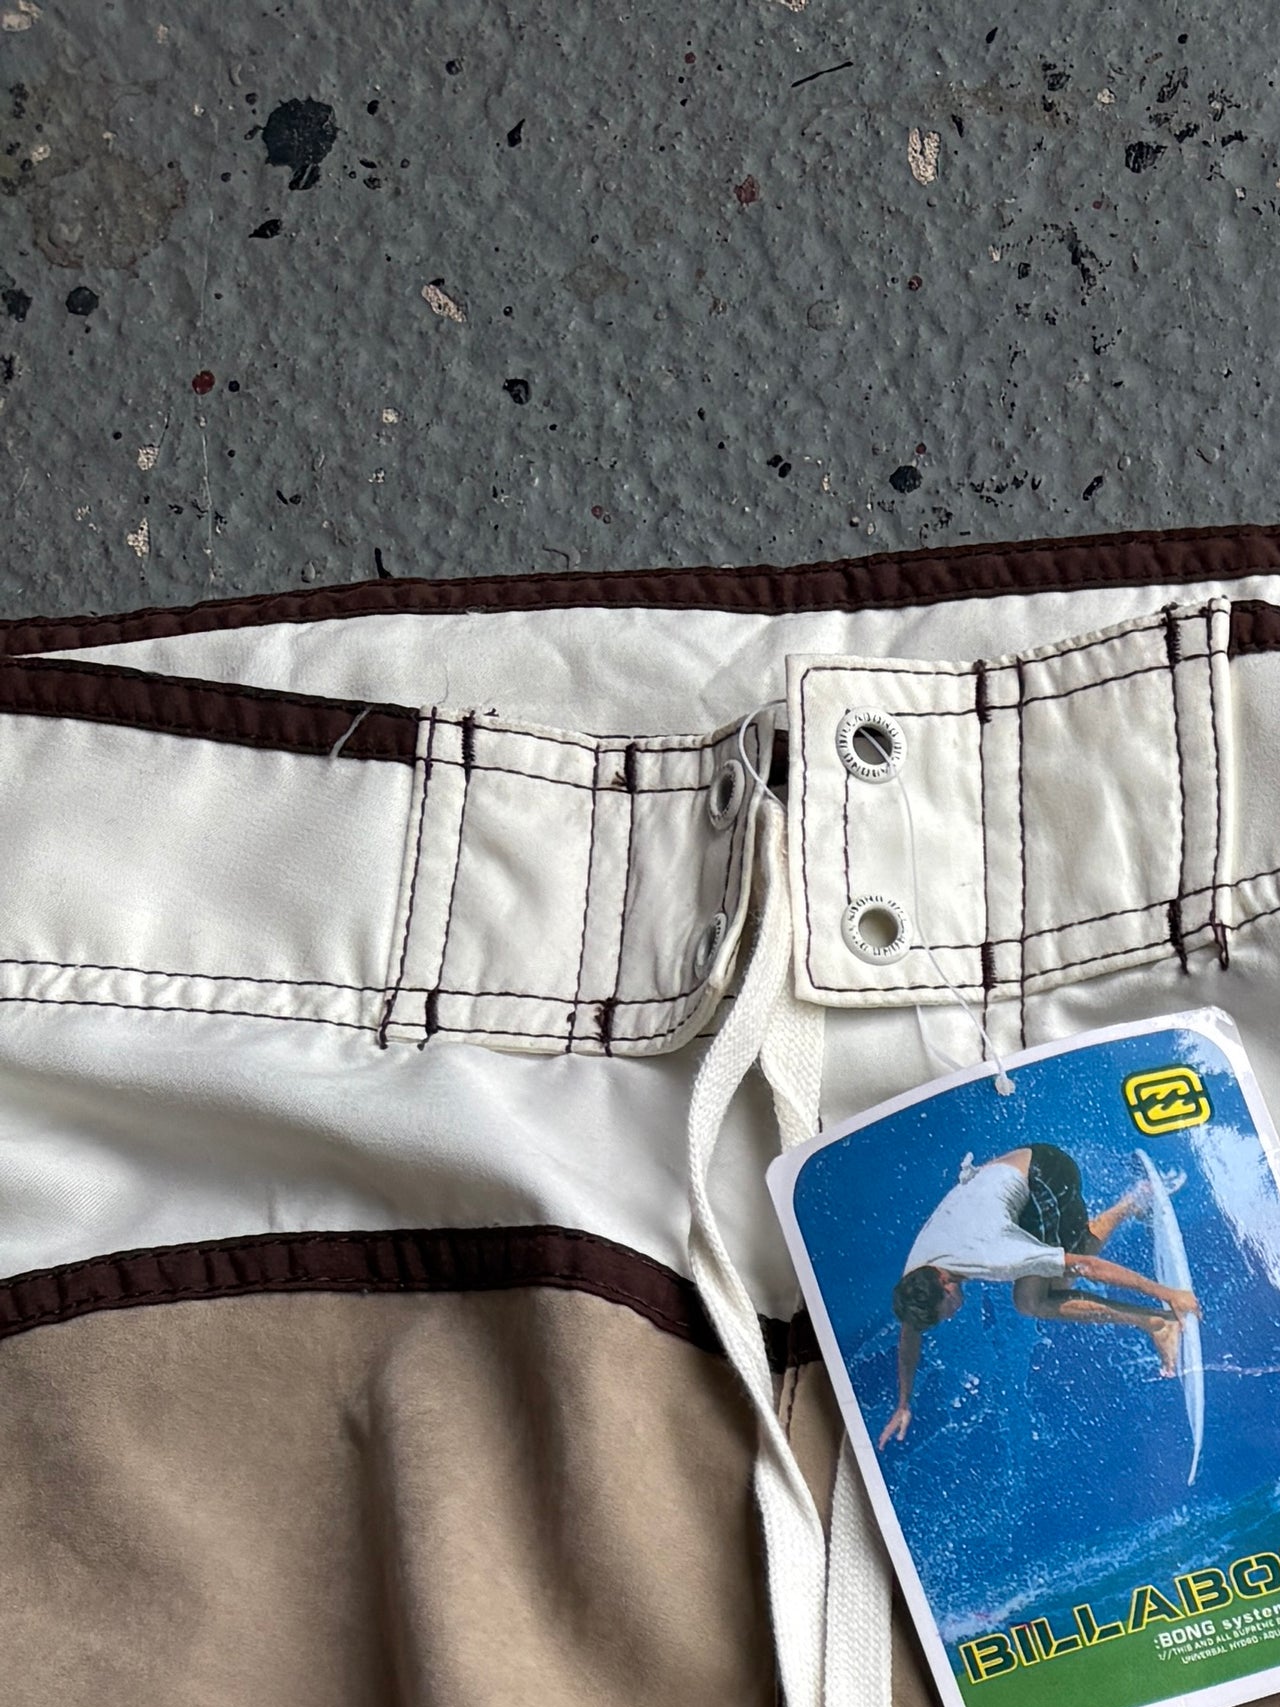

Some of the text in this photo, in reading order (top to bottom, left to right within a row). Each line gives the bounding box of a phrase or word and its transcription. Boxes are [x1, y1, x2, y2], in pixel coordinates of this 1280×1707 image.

[1195, 1638, 1214, 1649] AND
[1216, 1634, 1232, 1643] ALL
[1233, 1619, 1274, 1638] SUPREME
[1181, 1646, 1227, 1664] UNIVERSAL
